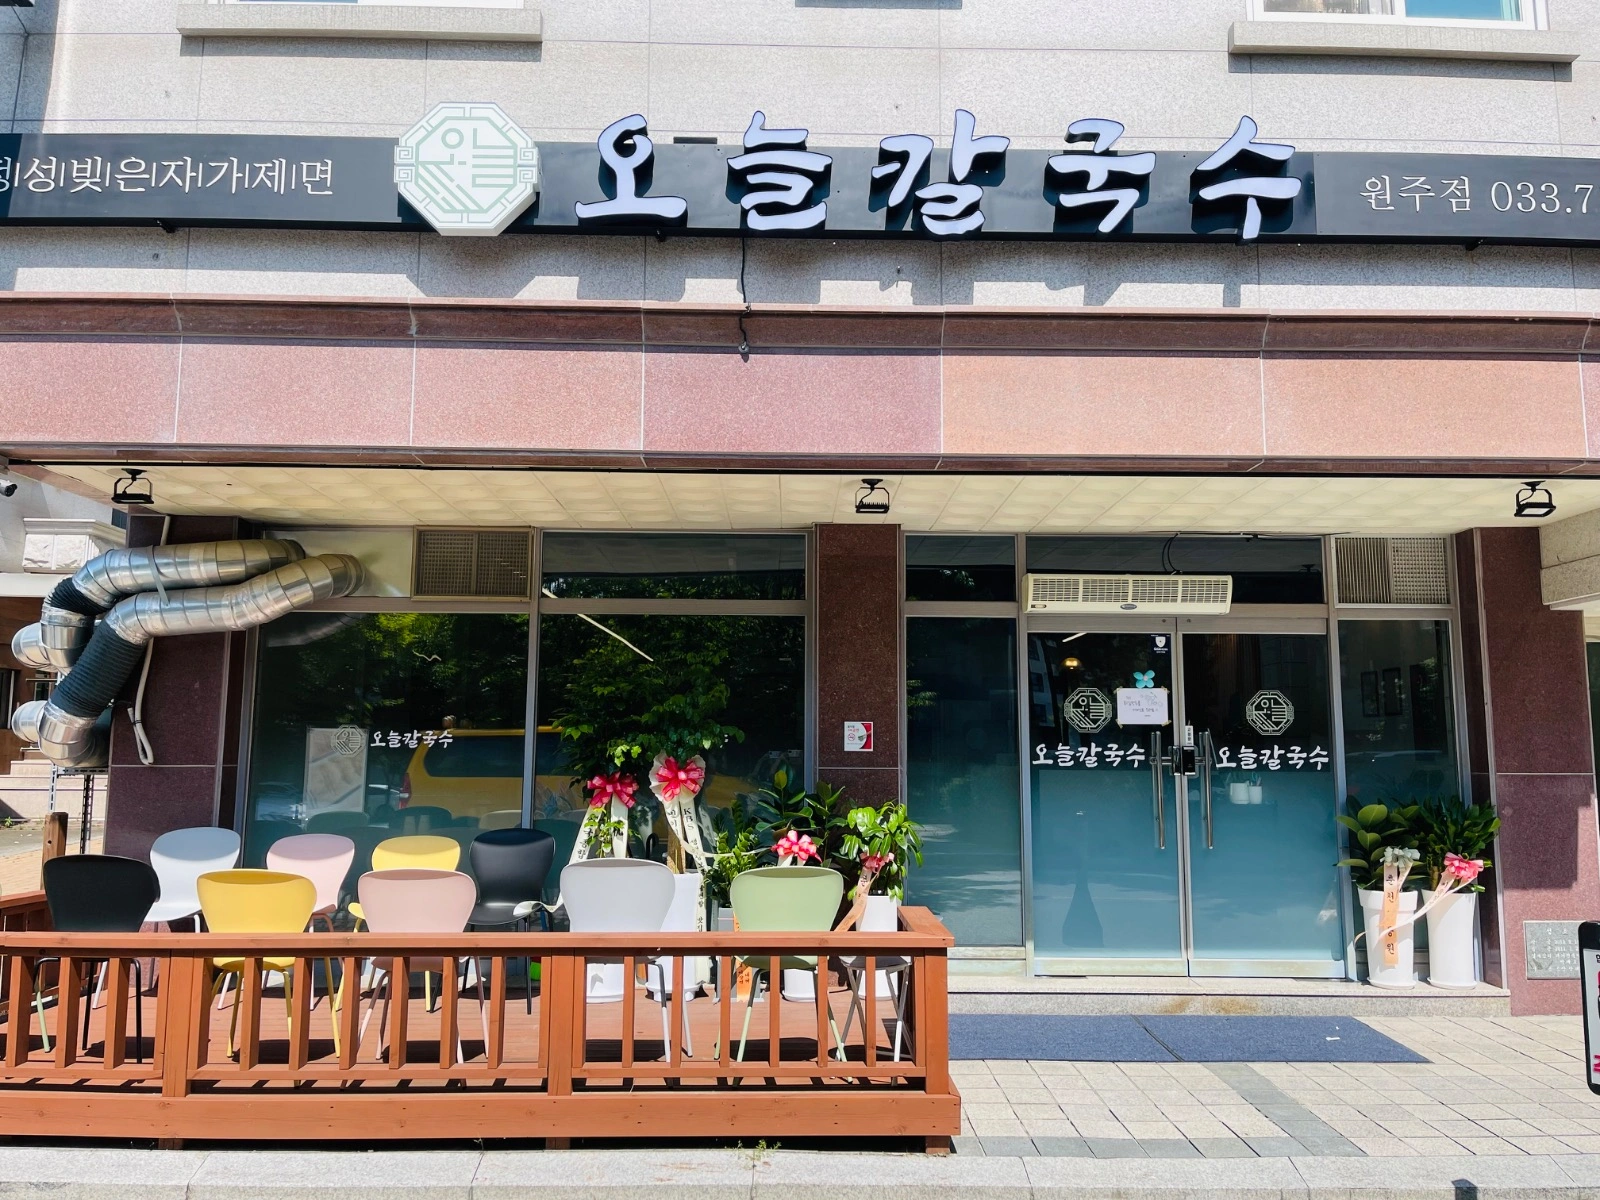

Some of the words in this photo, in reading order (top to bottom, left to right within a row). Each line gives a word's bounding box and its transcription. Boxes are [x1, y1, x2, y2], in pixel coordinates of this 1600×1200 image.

[574, 109, 1302, 240] 오늘칼국수
[1359, 174, 1472, 213] 원주점
[1490, 181, 1594, 214] 033.7
[370, 730, 454, 749] 오늘칼국수
[1032, 743, 1146, 768] 오늘칼국수
[1215, 745, 1330, 771] 오늘칼국수
